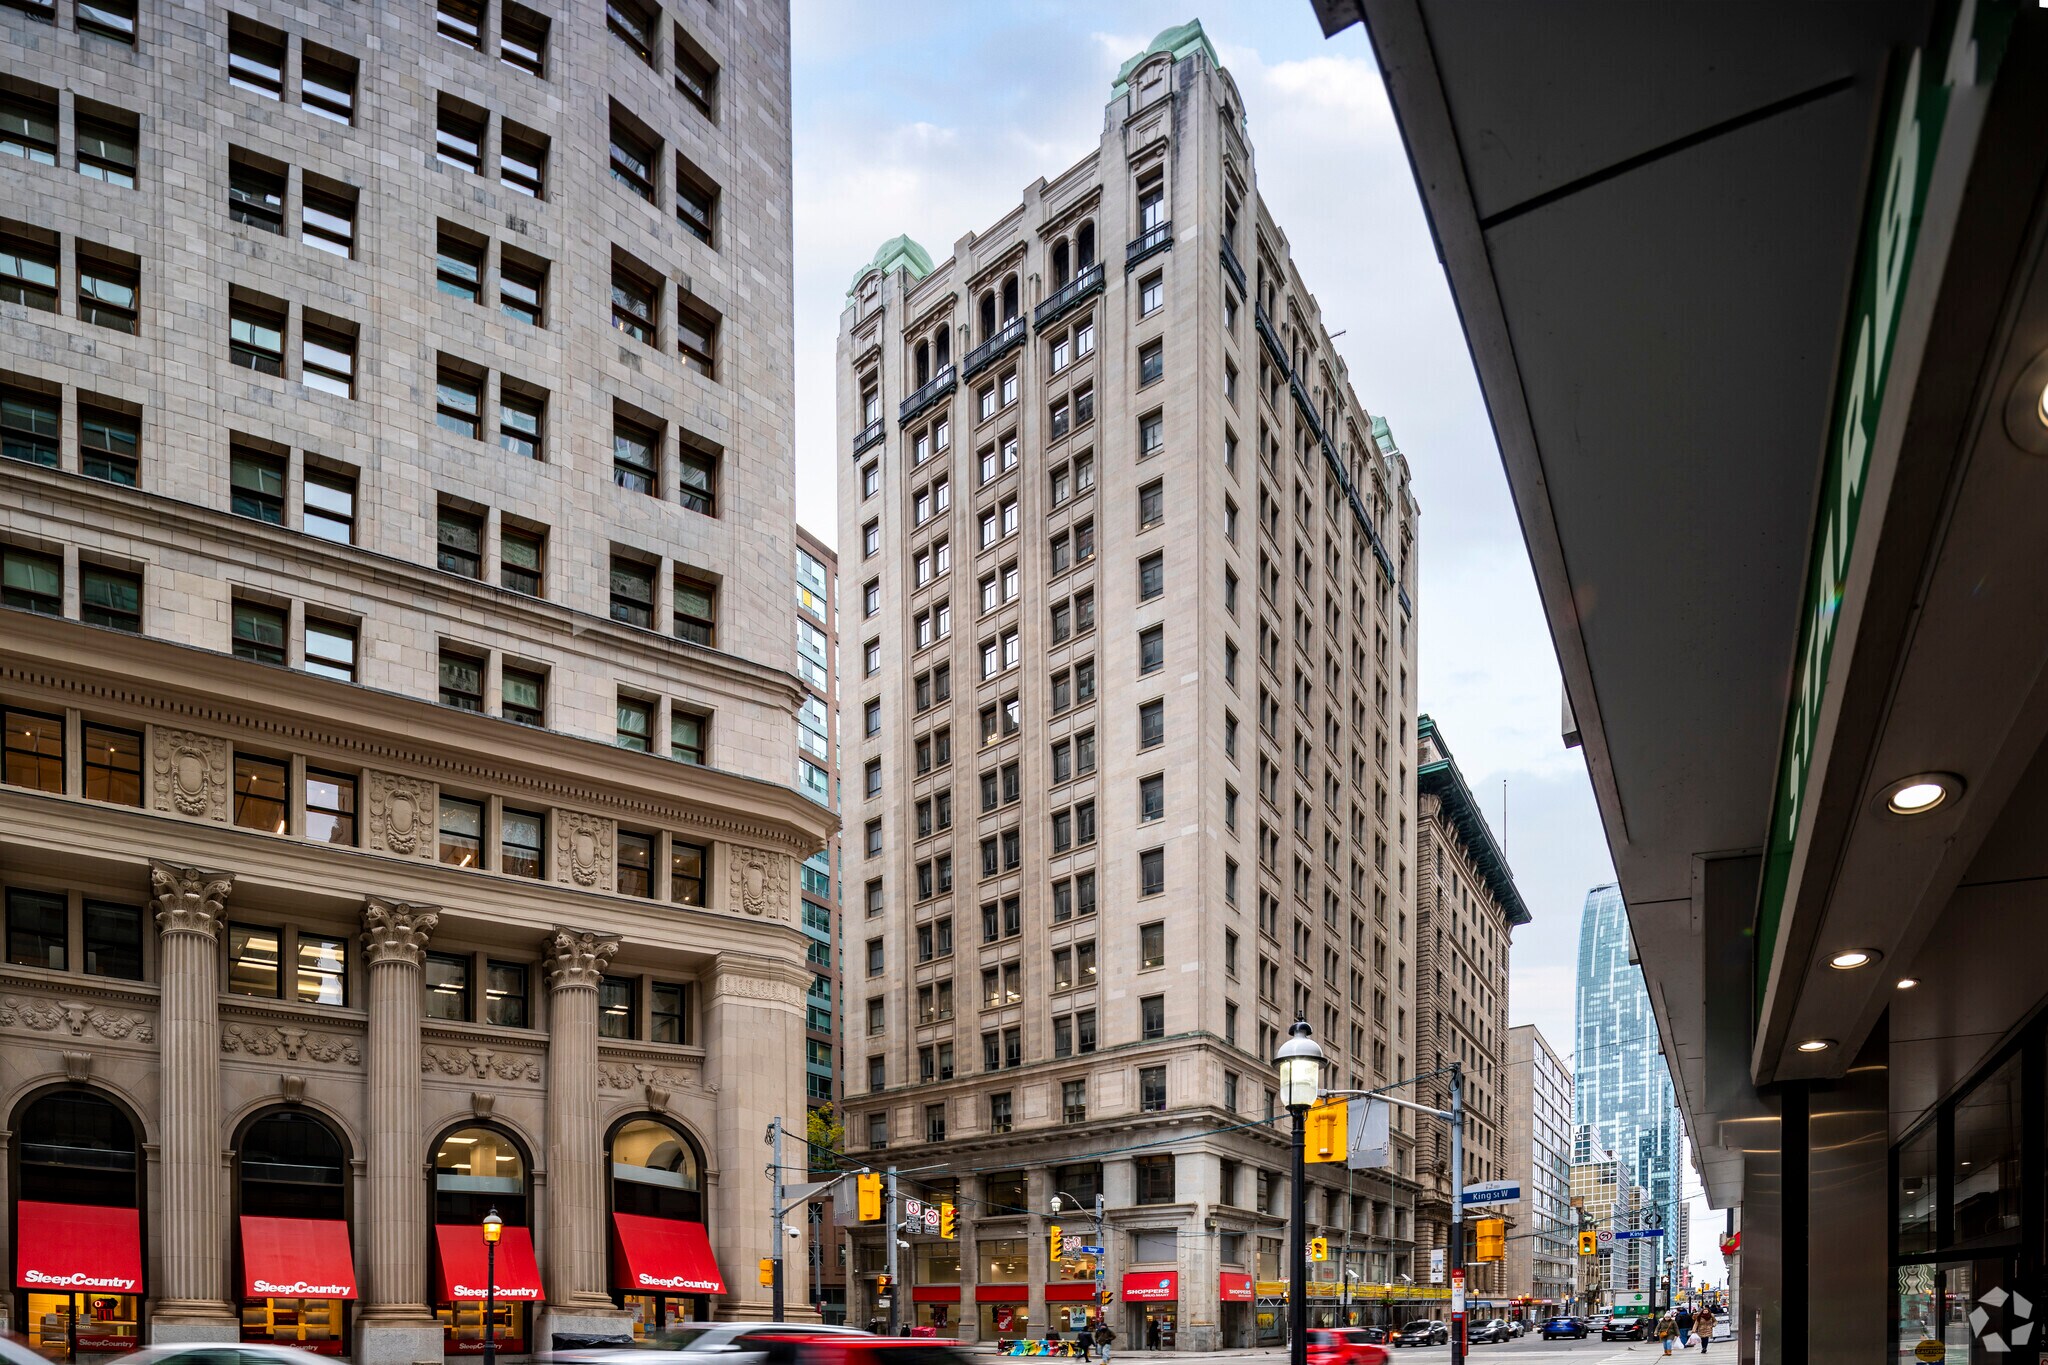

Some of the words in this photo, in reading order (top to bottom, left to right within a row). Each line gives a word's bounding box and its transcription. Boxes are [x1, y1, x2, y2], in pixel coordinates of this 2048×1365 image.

[1472, 1192, 1492, 1201] King
[1501, 1189, 1509, 1197] W
[24, 1269, 135, 1289] SleepCountry
[639, 1273, 719, 1291] SleepCountry
[253, 1280, 350, 1296] SleepCountry
[453, 1285, 538, 1298] SleepCountry
[79, 1338, 134, 1348] SleepCountry
[289, 1343, 319, 1352] Country
